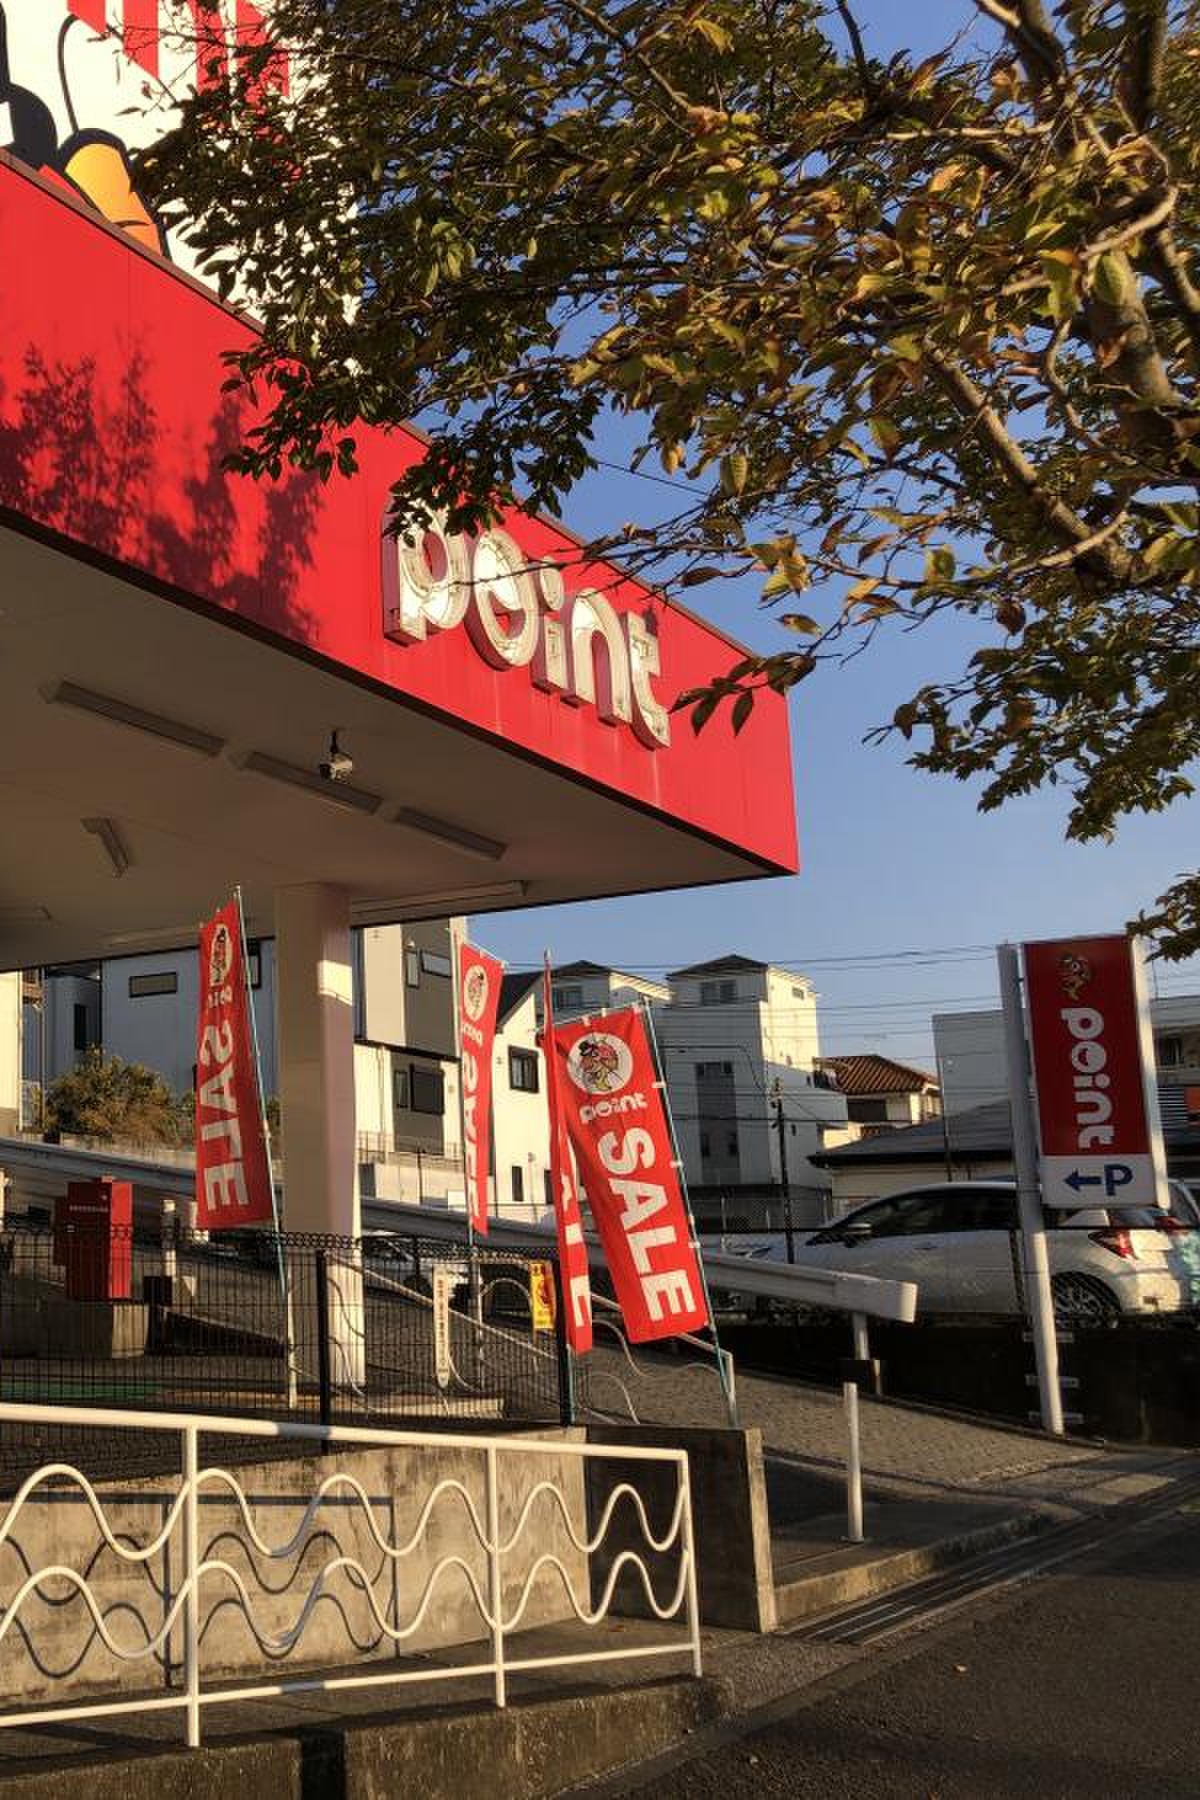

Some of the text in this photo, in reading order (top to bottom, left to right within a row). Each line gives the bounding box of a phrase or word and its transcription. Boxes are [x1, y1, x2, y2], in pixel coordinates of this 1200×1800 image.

[386, 492, 671, 750] point
[578, 1092, 648, 1125] point
[1060, 1007, 1115, 1149] point
[598, 1127, 697, 1322] SALE
[1104, 1163, 1133, 1196] P
